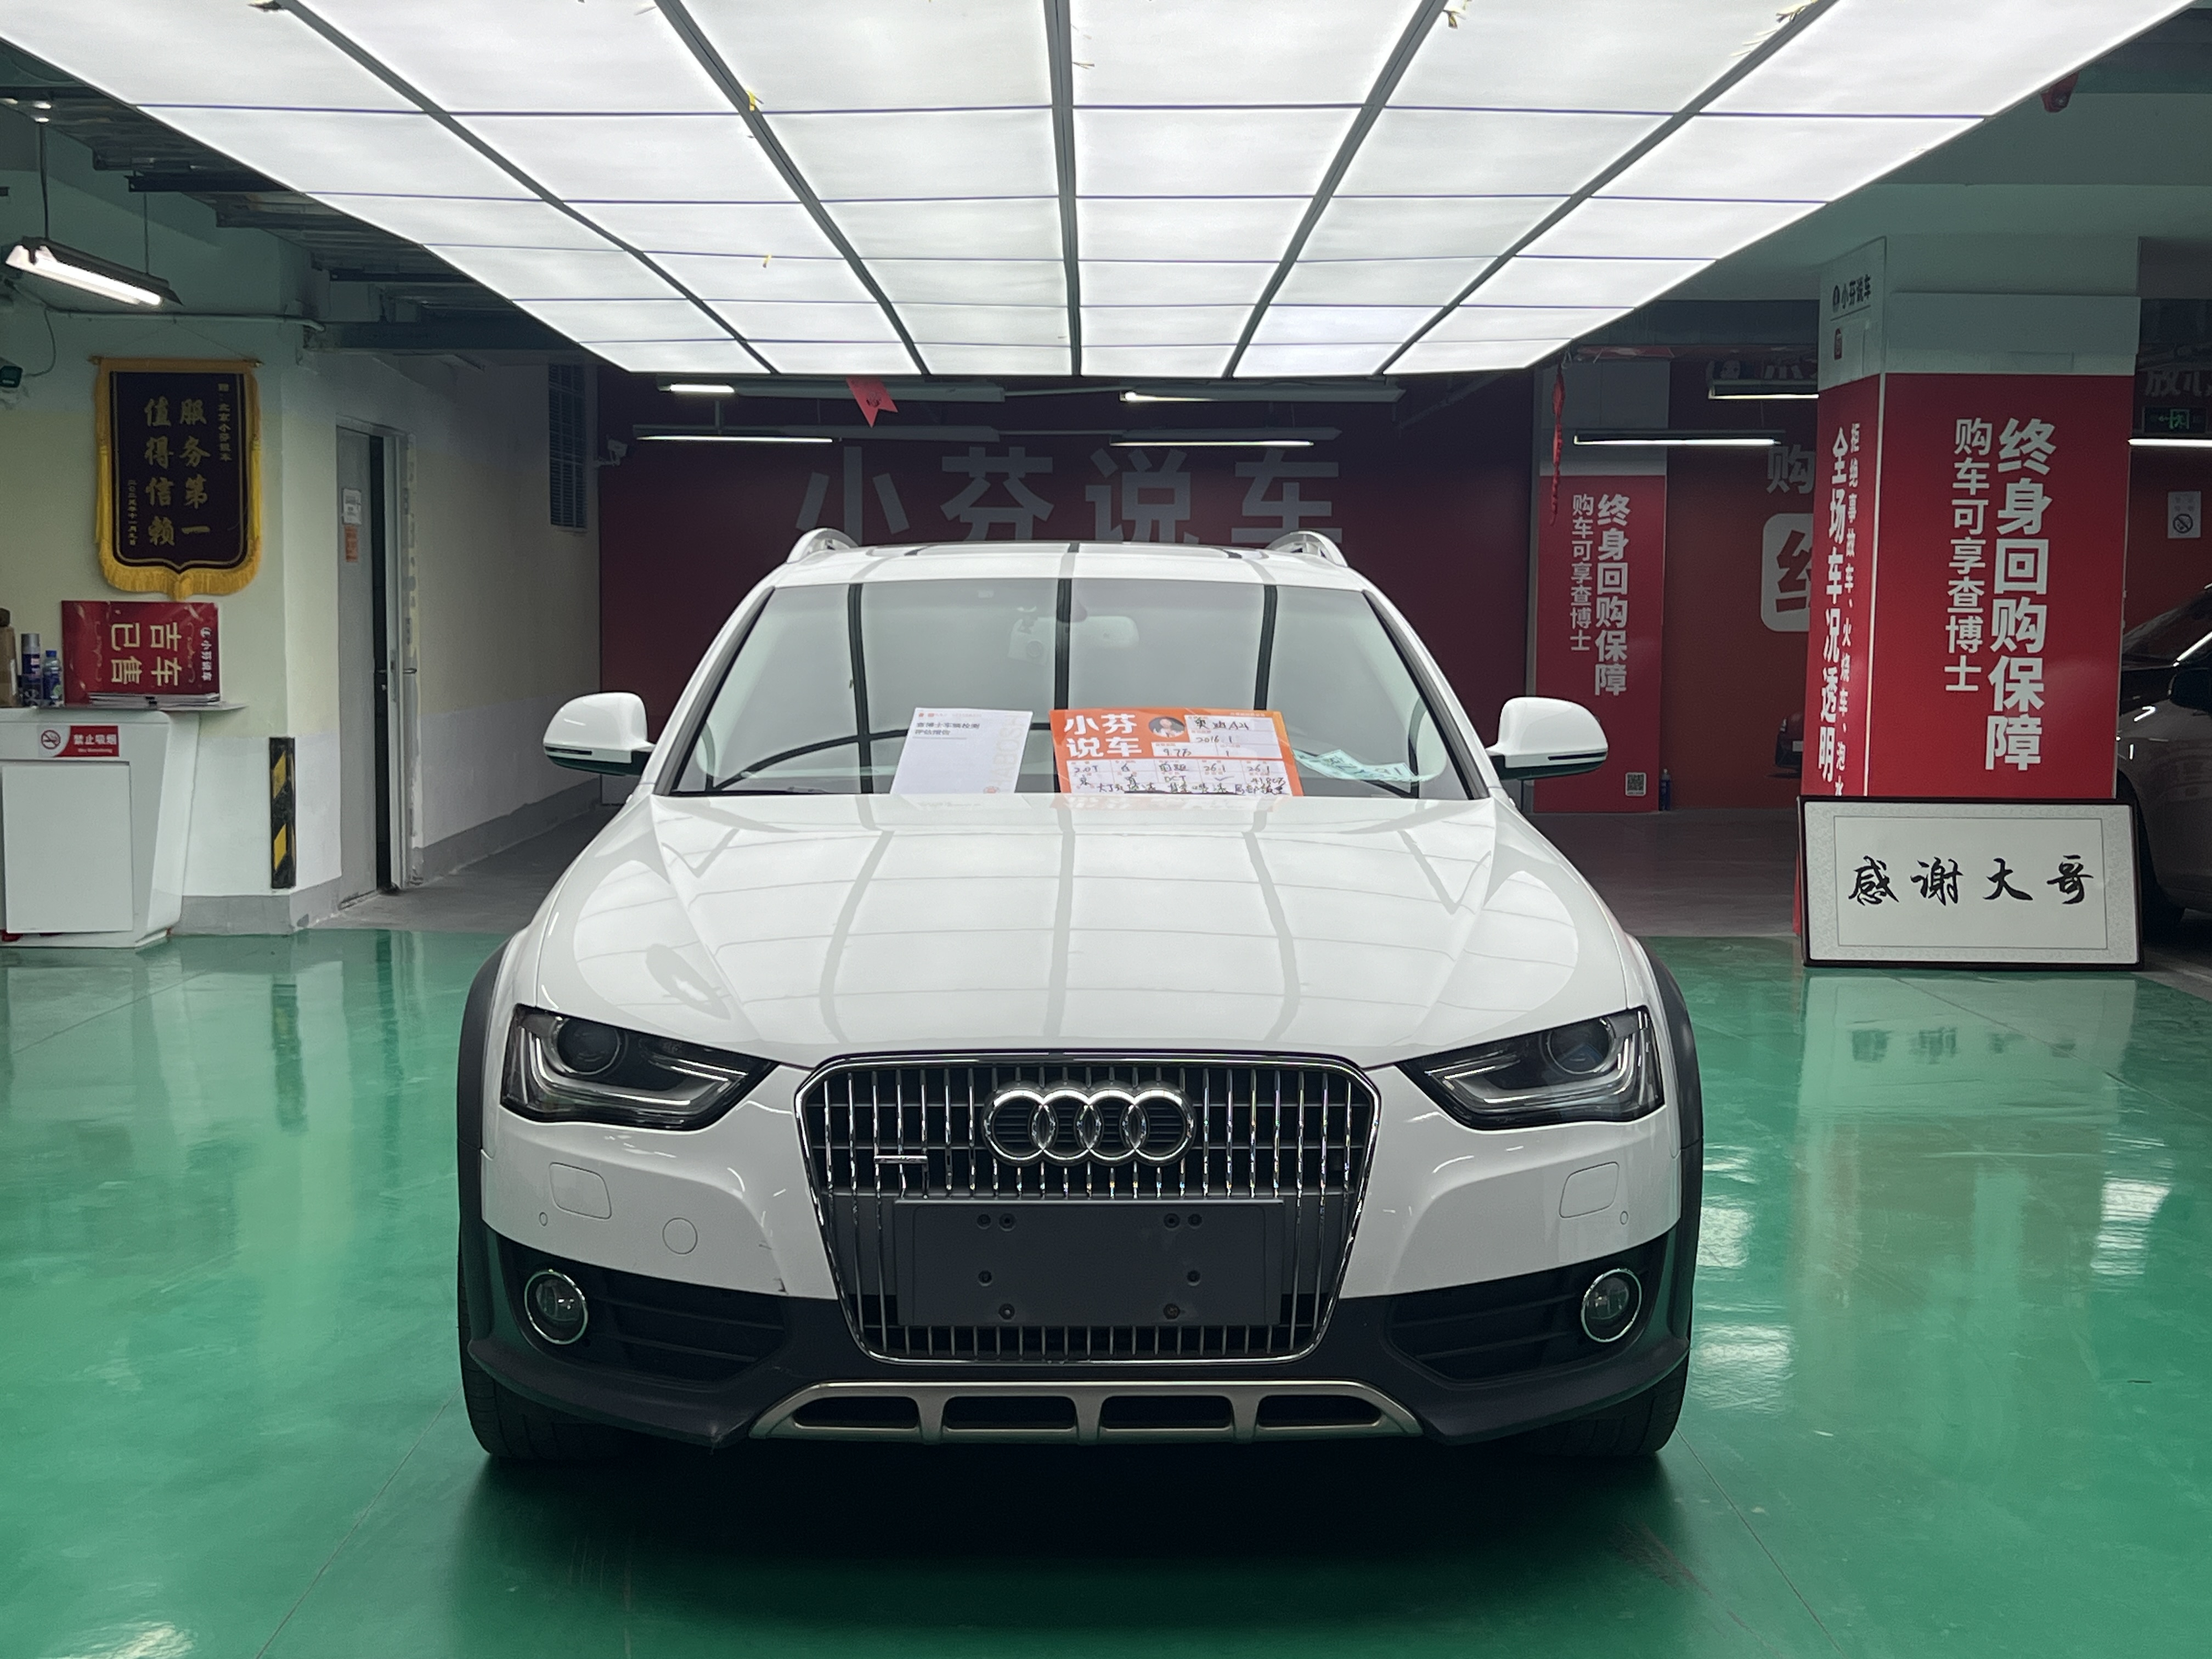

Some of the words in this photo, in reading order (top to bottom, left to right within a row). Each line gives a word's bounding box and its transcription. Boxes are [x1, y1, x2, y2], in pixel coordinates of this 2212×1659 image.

[144, 396, 176, 548] 值得信赖
[179, 399, 210, 536] 服务第一
[795, 444, 1343, 546] 小芬说车
[1570, 494, 1594, 652] 购车可享查博士
[1594, 494, 1630, 696] 终身回购保障
[1818, 427, 1849, 783] 全场车况透明
[1944, 418, 1992, 692] 购车可享查博士
[1984, 417, 2056, 771] 终身回购保障
[111, 622, 143, 685] 已售
[150, 621, 183, 687] 吉车
[74, 733, 117, 746] 禁止吸烟
[1064, 714, 1137, 736] 小芬
[1066, 737, 1143, 758] 说车
[1848, 855, 2094, 906] 感谢大哥
